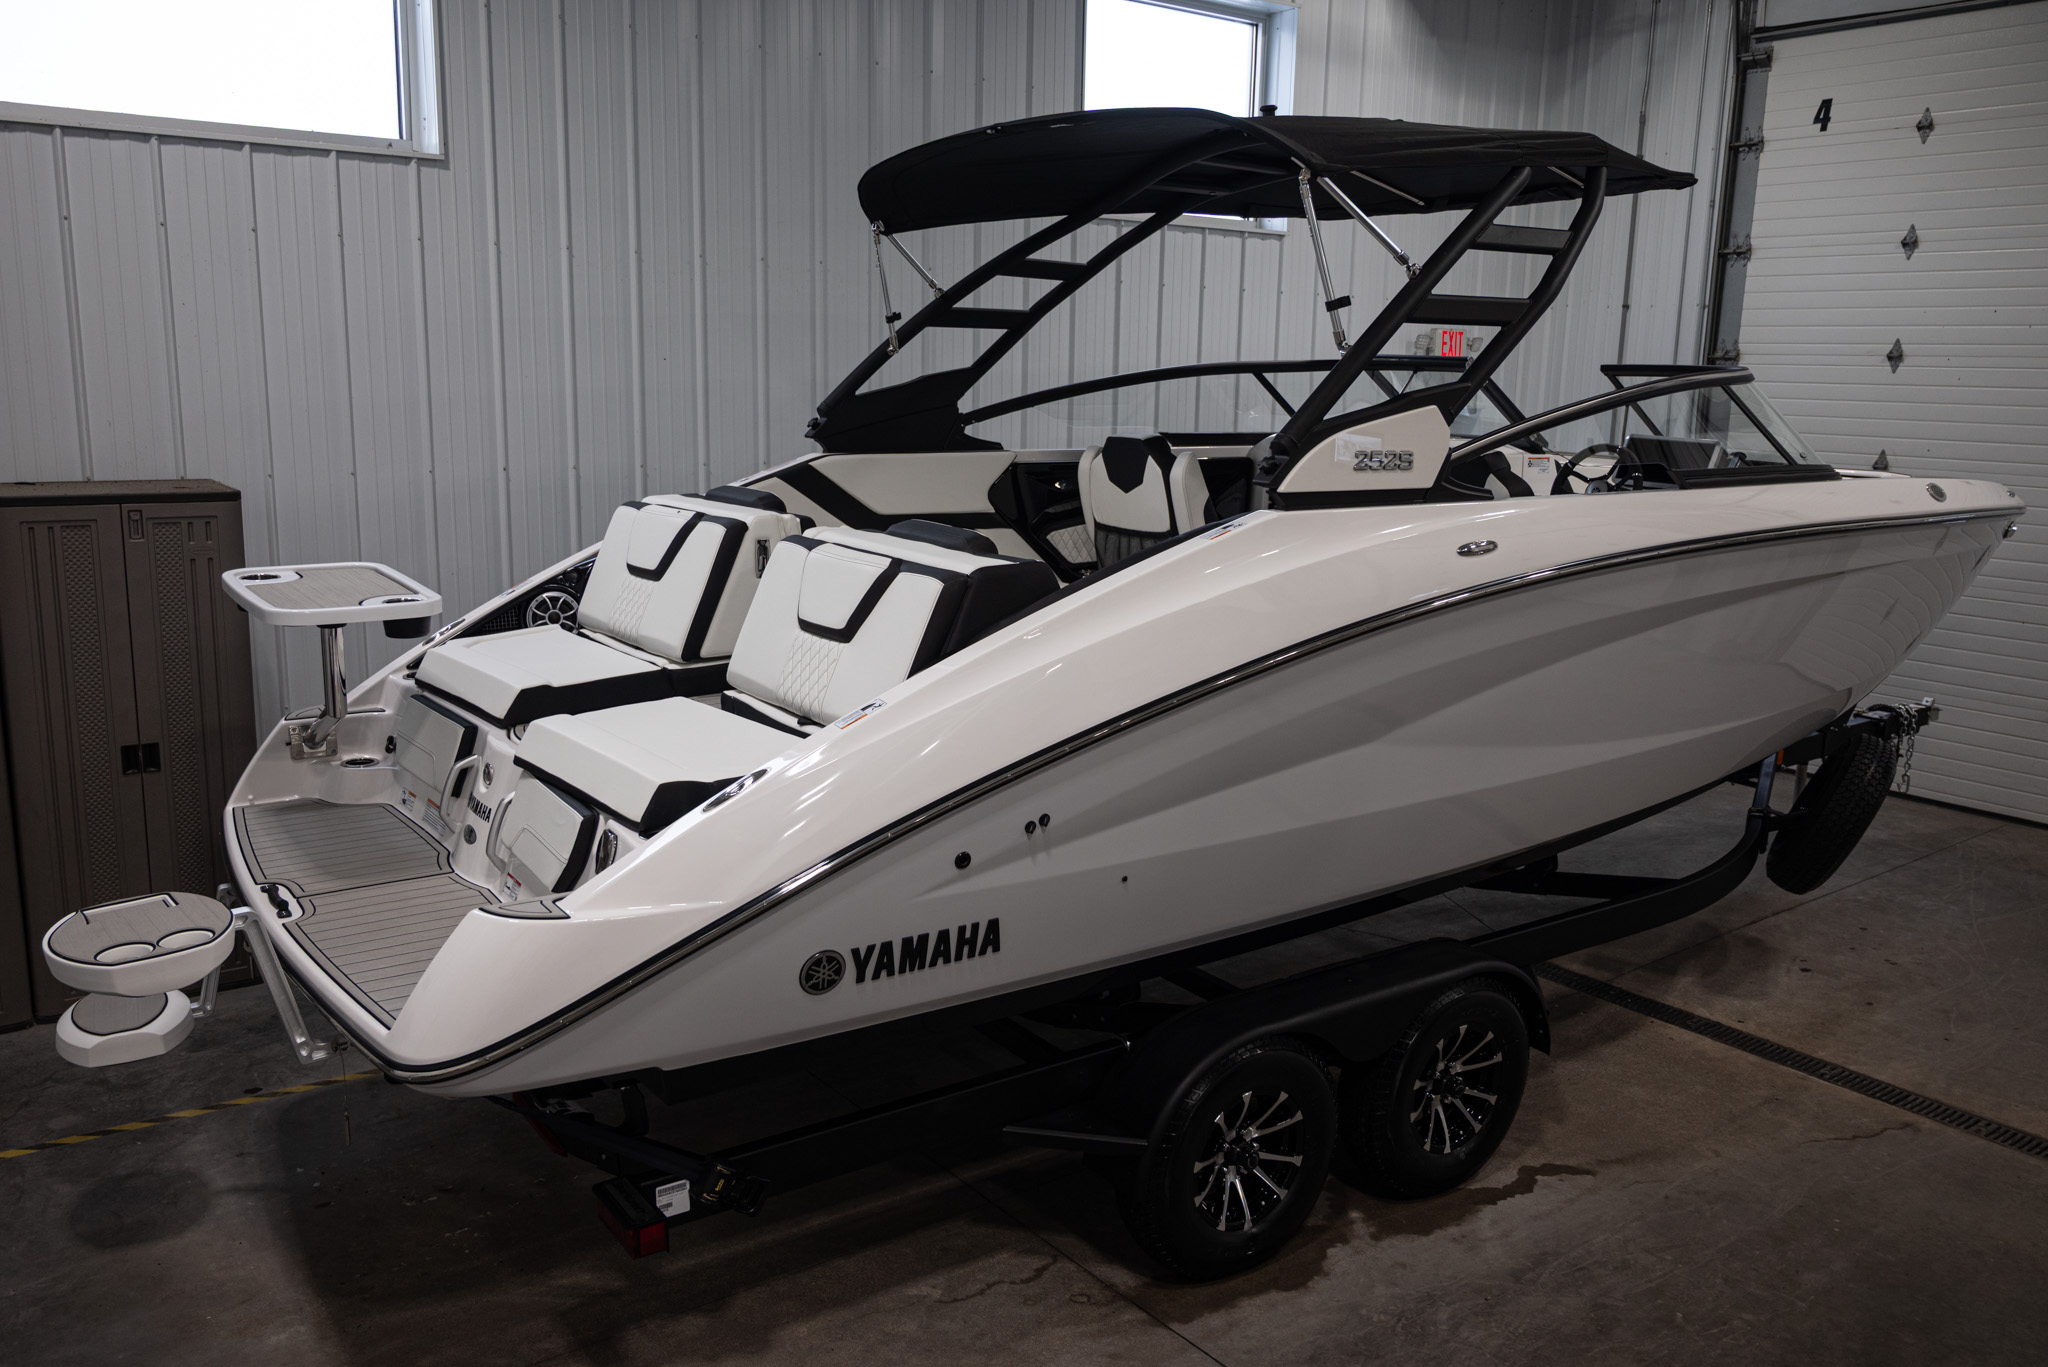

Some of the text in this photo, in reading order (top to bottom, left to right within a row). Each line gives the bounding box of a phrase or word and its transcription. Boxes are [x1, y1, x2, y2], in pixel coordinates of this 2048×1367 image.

[1813, 98, 1833, 132] 4
[1441, 330, 1464, 357] EXIT
[467, 791, 492, 823] YAMAHA
[850, 917, 1001, 984] YAMAHA
